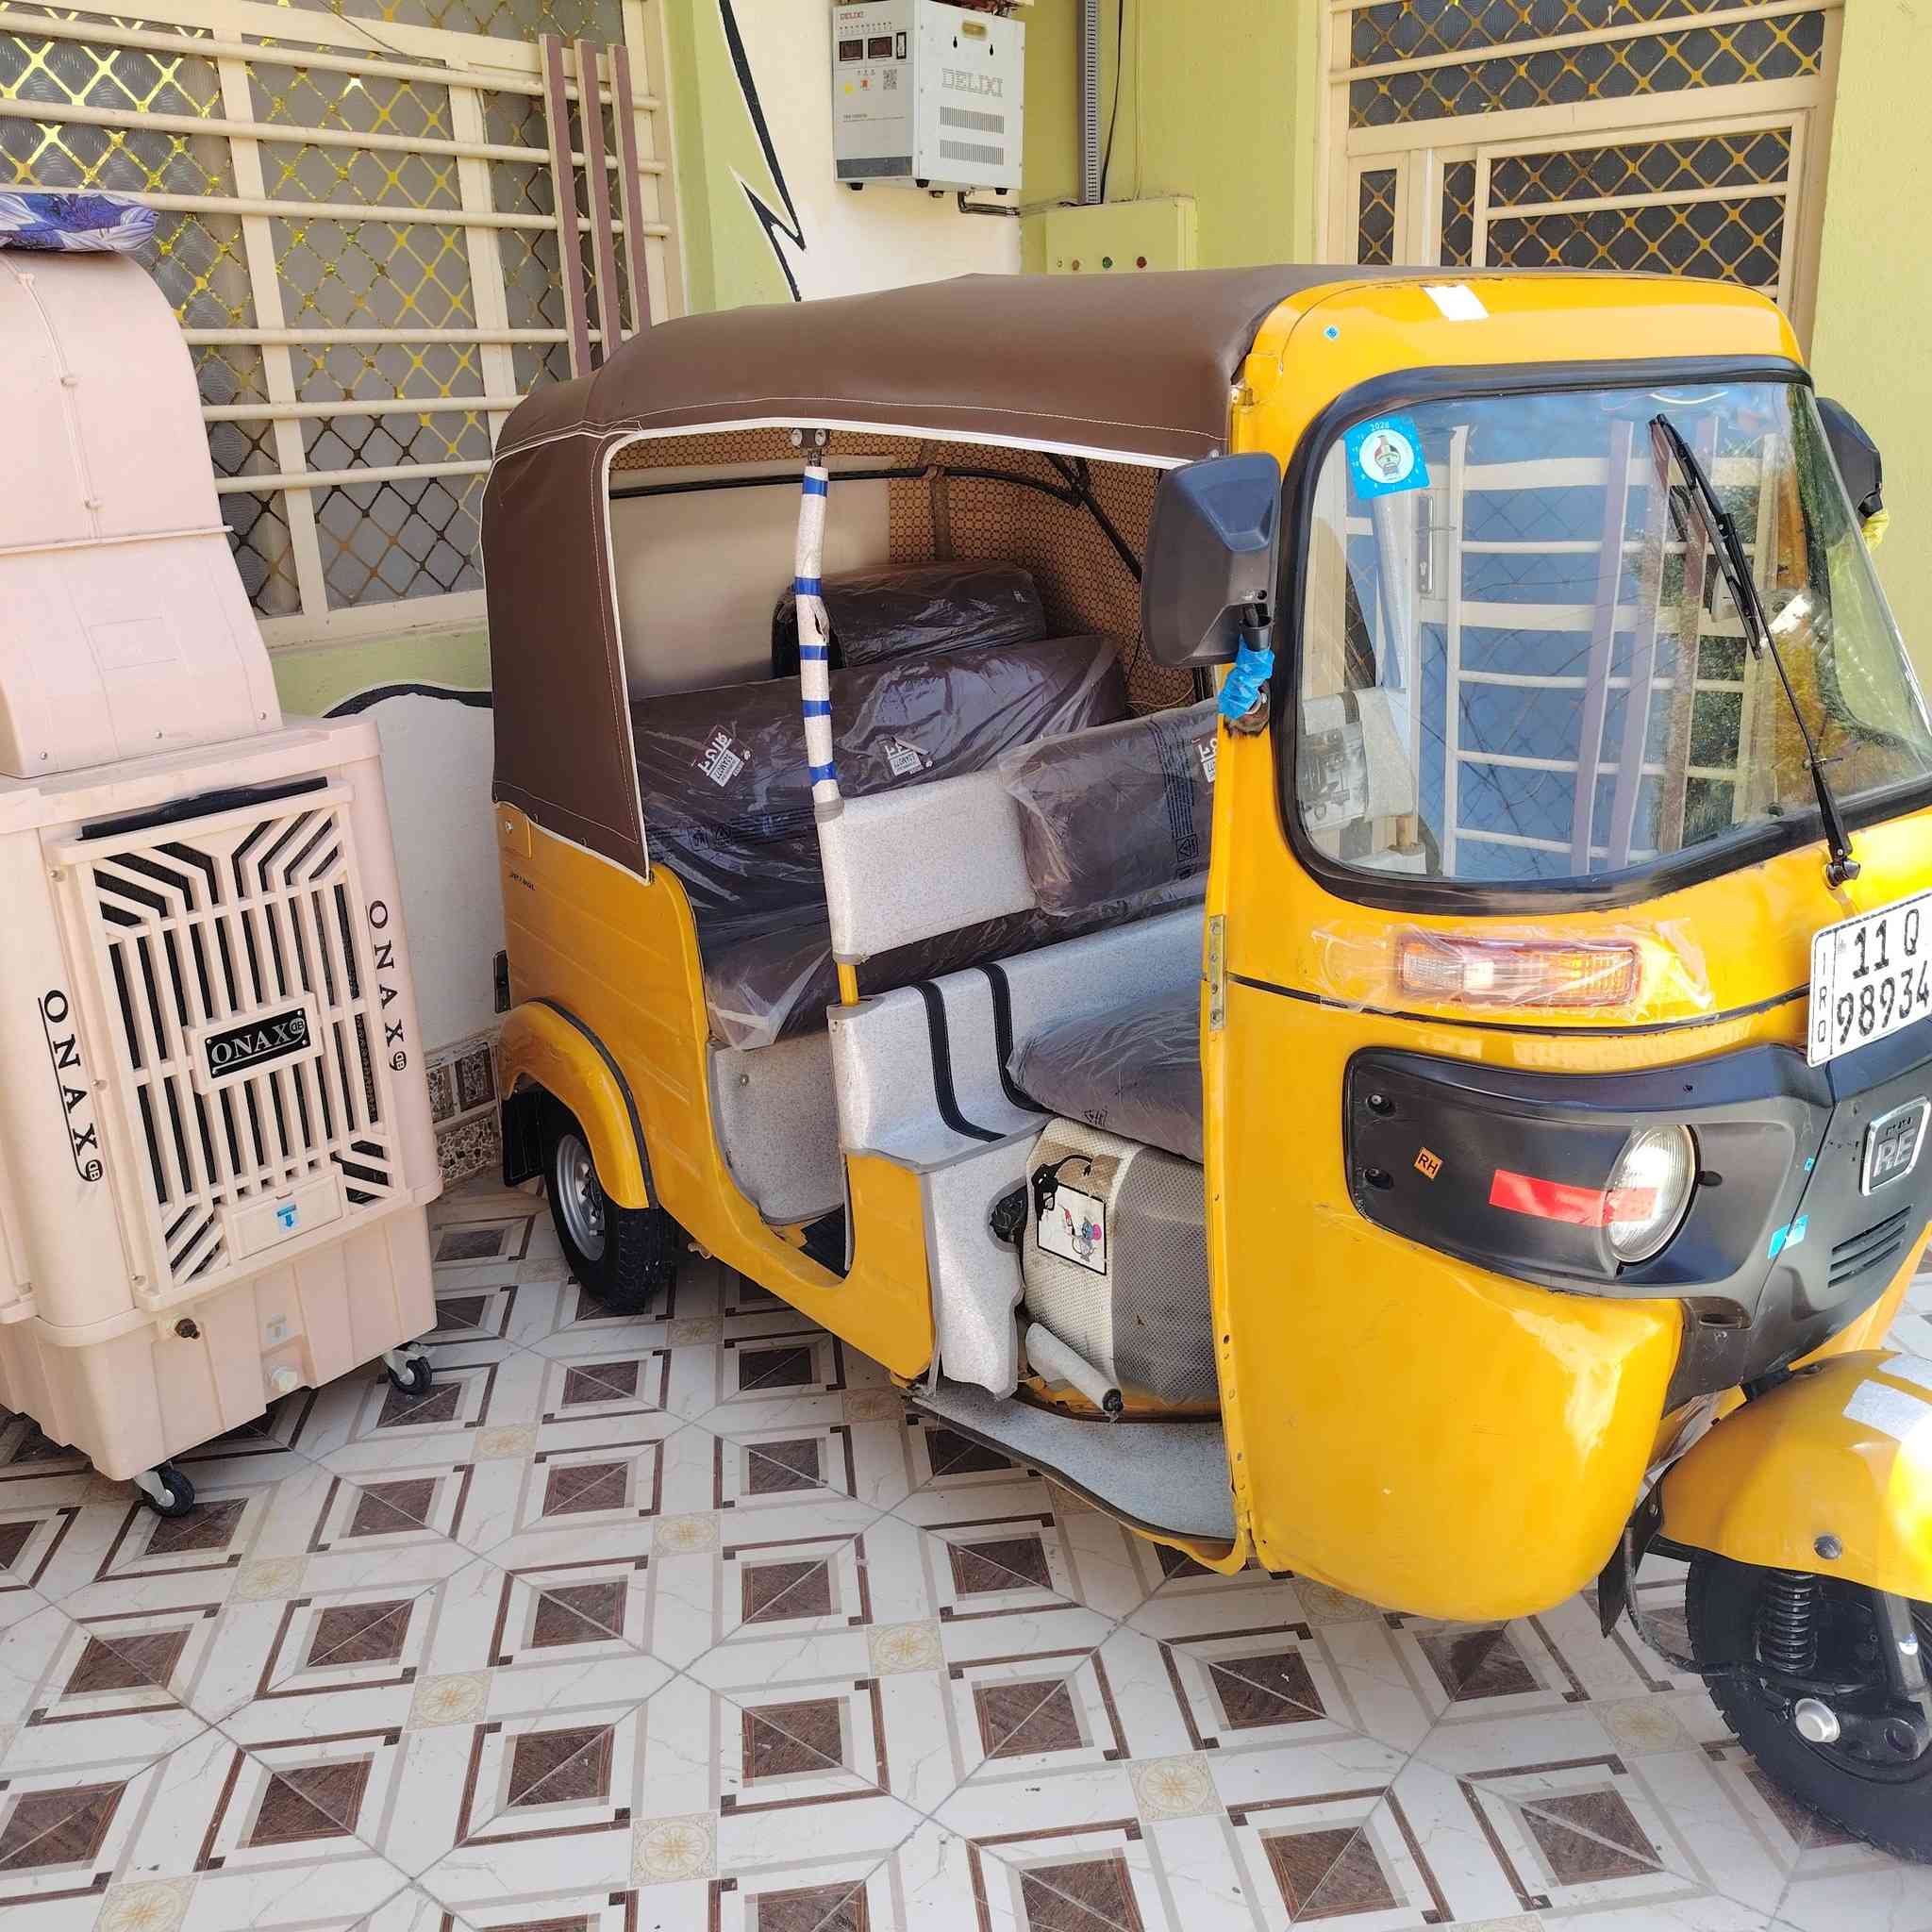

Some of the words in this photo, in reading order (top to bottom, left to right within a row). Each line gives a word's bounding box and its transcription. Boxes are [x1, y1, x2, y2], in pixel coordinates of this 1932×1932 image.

[942, 68, 1004, 98] DELIXI
[369, 900, 405, 1047] ONAX
[1853, 919, 1890, 979] 11
[1836, 960, 1930, 1045] 98934
[210, 1022, 294, 1065] ONAX
[43, 990, 99, 1157] ONAX
[1418, 1153, 1439, 1174] RH
[1873, 1127, 1916, 1177] RE
